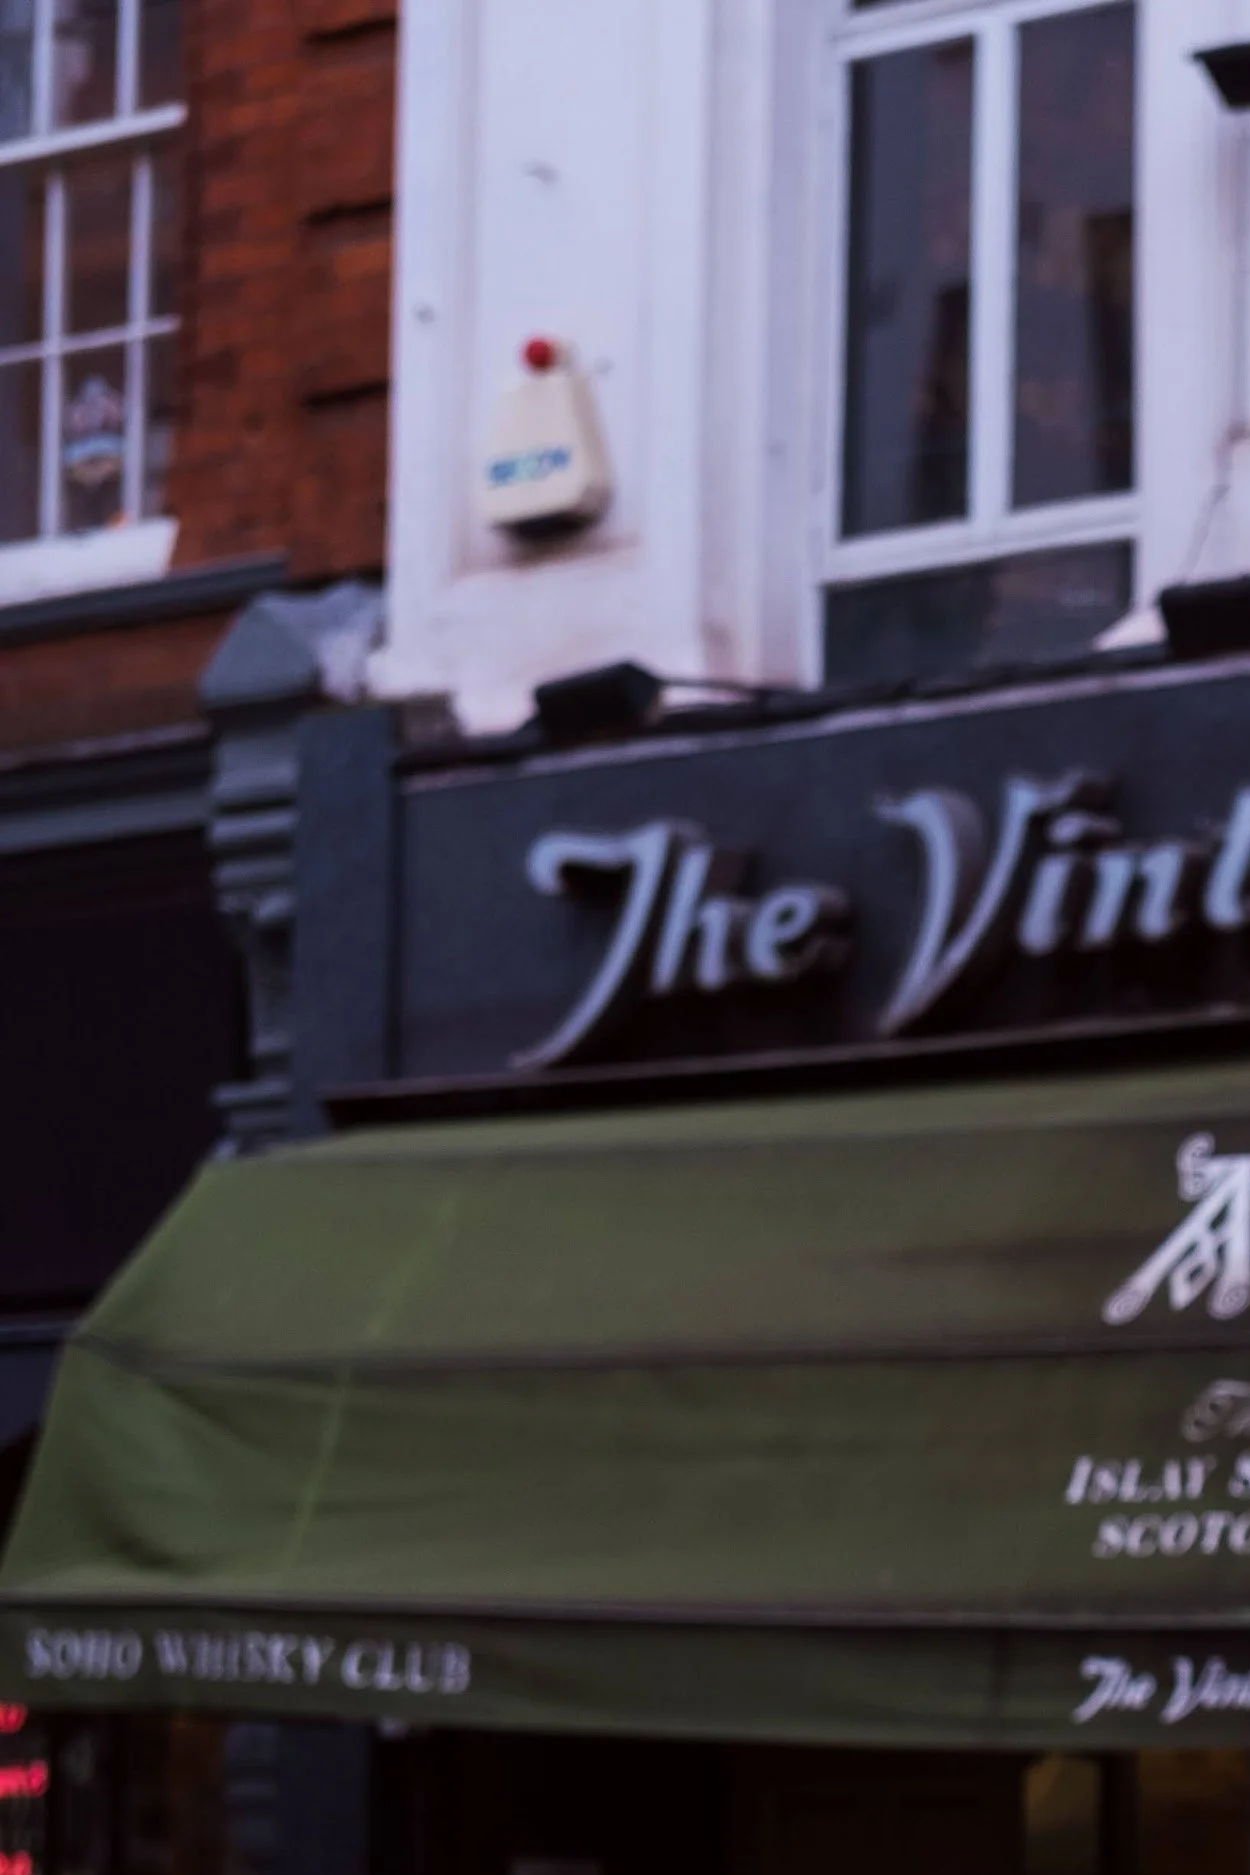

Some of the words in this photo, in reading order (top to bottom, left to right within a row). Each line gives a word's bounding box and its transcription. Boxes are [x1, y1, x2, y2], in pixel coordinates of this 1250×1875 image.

[510, 816, 838, 1071] The
[25, 1627, 143, 1680] SOHO
[152, 1629, 335, 1685] WHISKY
[340, 1639, 472, 1695] CLUB
[1072, 1656, 1157, 1725] The
